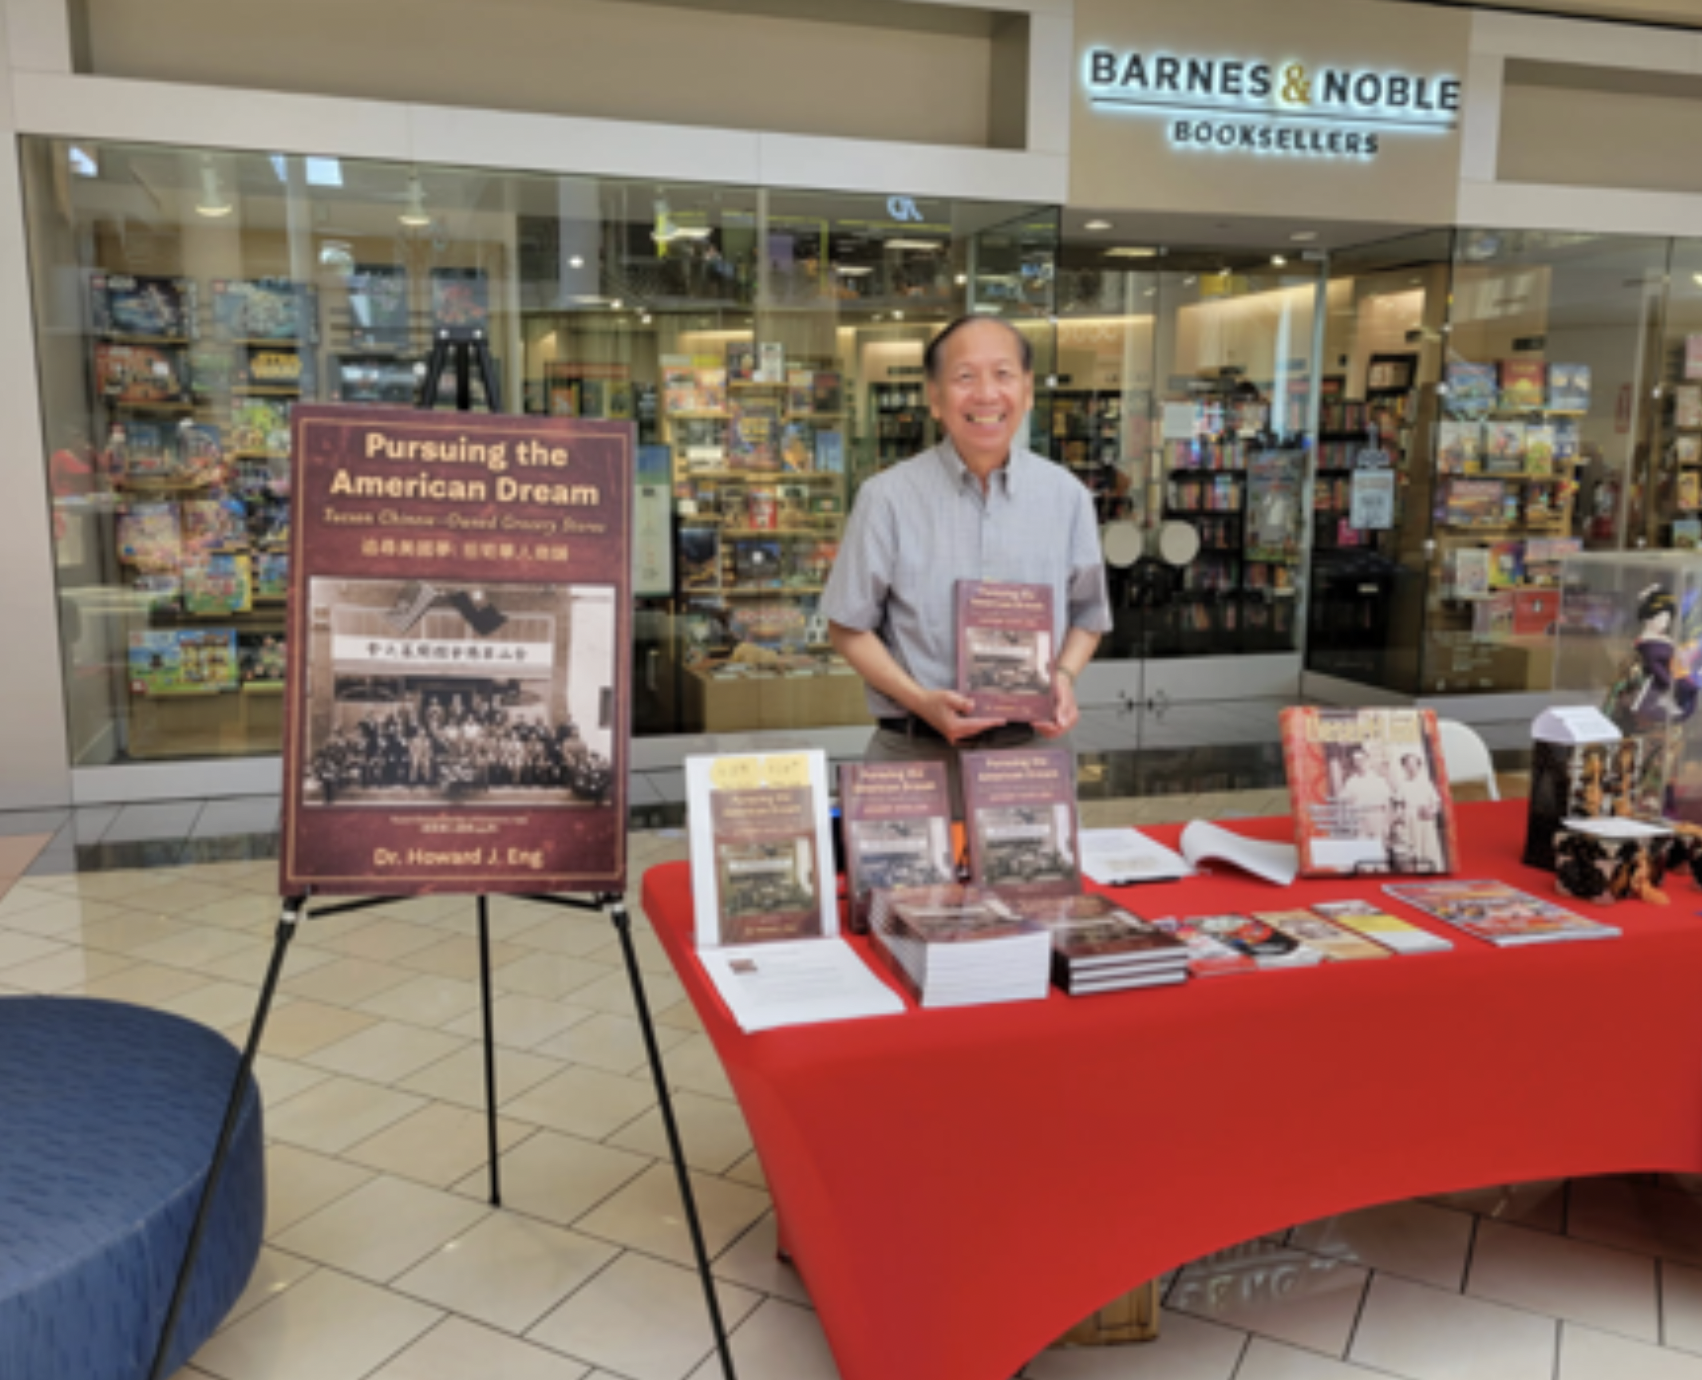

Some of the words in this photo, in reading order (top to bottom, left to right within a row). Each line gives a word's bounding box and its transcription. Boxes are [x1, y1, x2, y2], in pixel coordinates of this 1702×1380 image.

[1091, 50, 1272, 97] BARNES
[1281, 64, 1311, 104] &
[1322, 68, 1462, 111] NOBLE
[1174, 121, 1379, 155] BOOKSELLERS
[364, 431, 508, 471] Pursuing
[515, 440, 569, 467] the
[329, 468, 487, 502] American
[495, 475, 600, 506] Dream
[372, 846, 403, 866] Dr.
[408, 846, 483, 867] Howard
[506, 847, 545, 870] Eng
